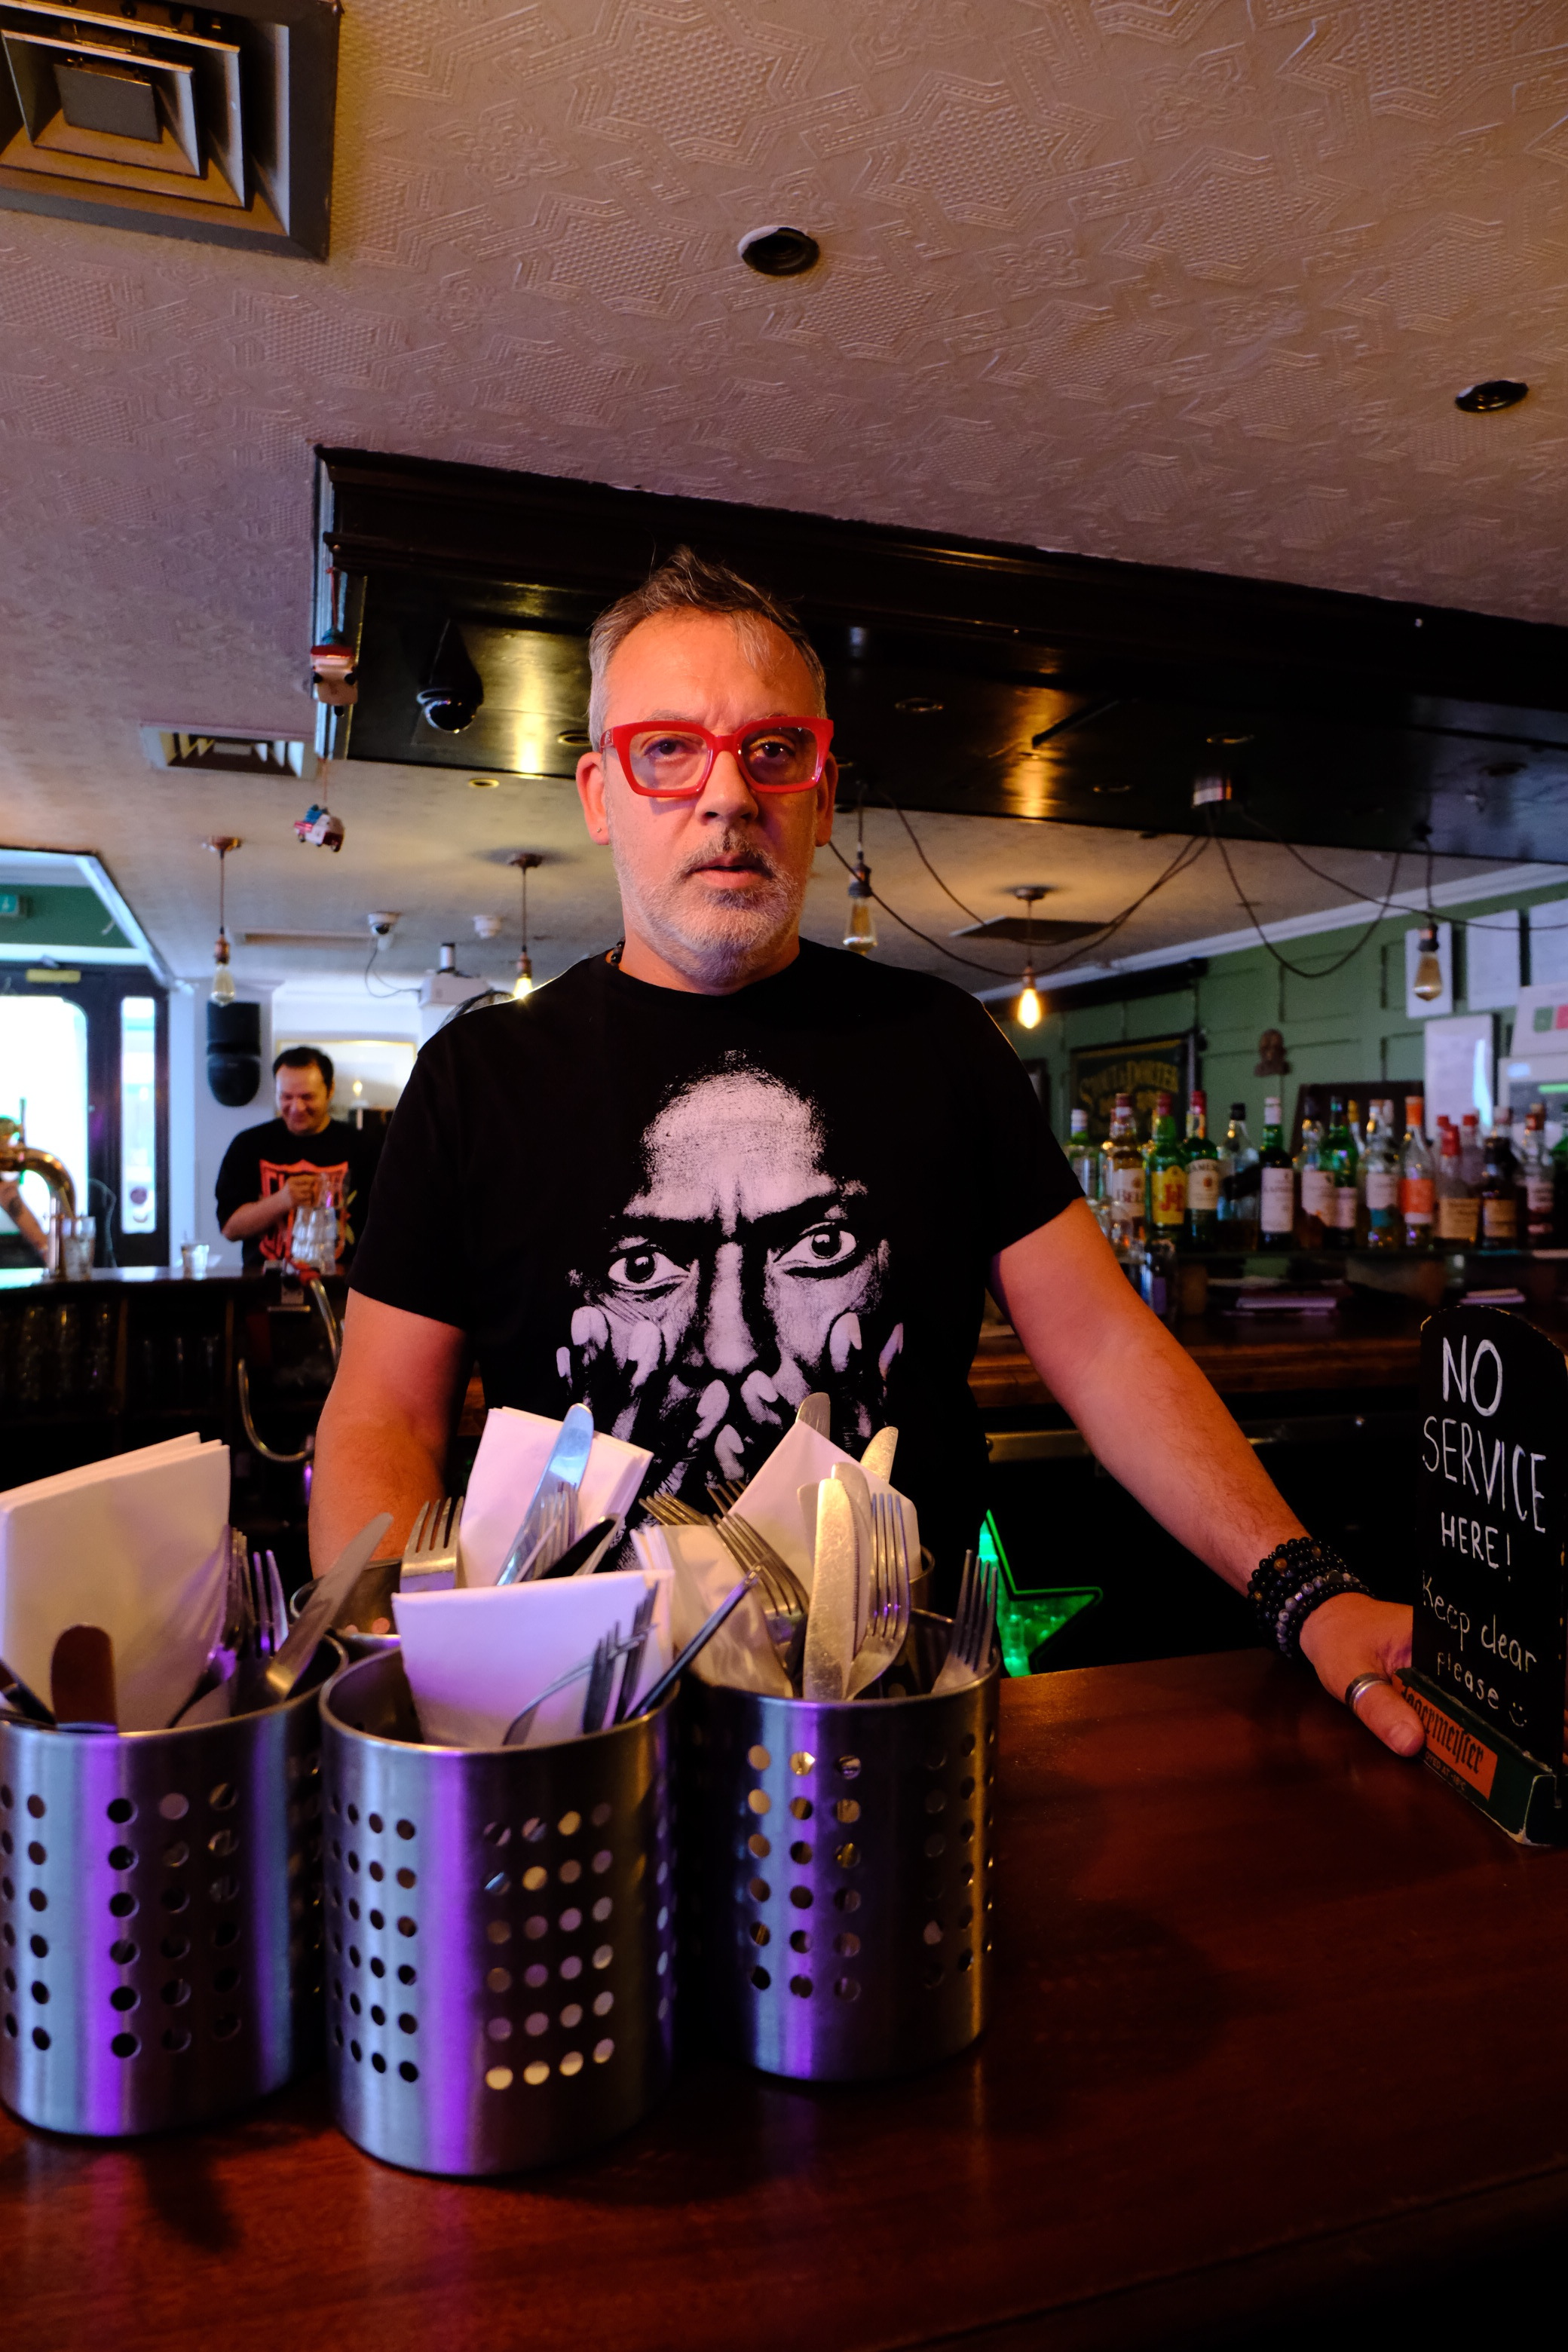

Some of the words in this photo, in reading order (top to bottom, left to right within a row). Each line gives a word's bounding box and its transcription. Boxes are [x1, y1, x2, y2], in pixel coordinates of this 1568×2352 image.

[1442, 1334, 1503, 1416] NO
[1422, 1415, 1547, 1533] SERVICE
[1441, 1511, 1511, 1582] HERE!
[1422, 1570, 1470, 1652] Keep
[1481, 1613, 1537, 1673] clear
[1437, 1651, 1499, 1710] please
